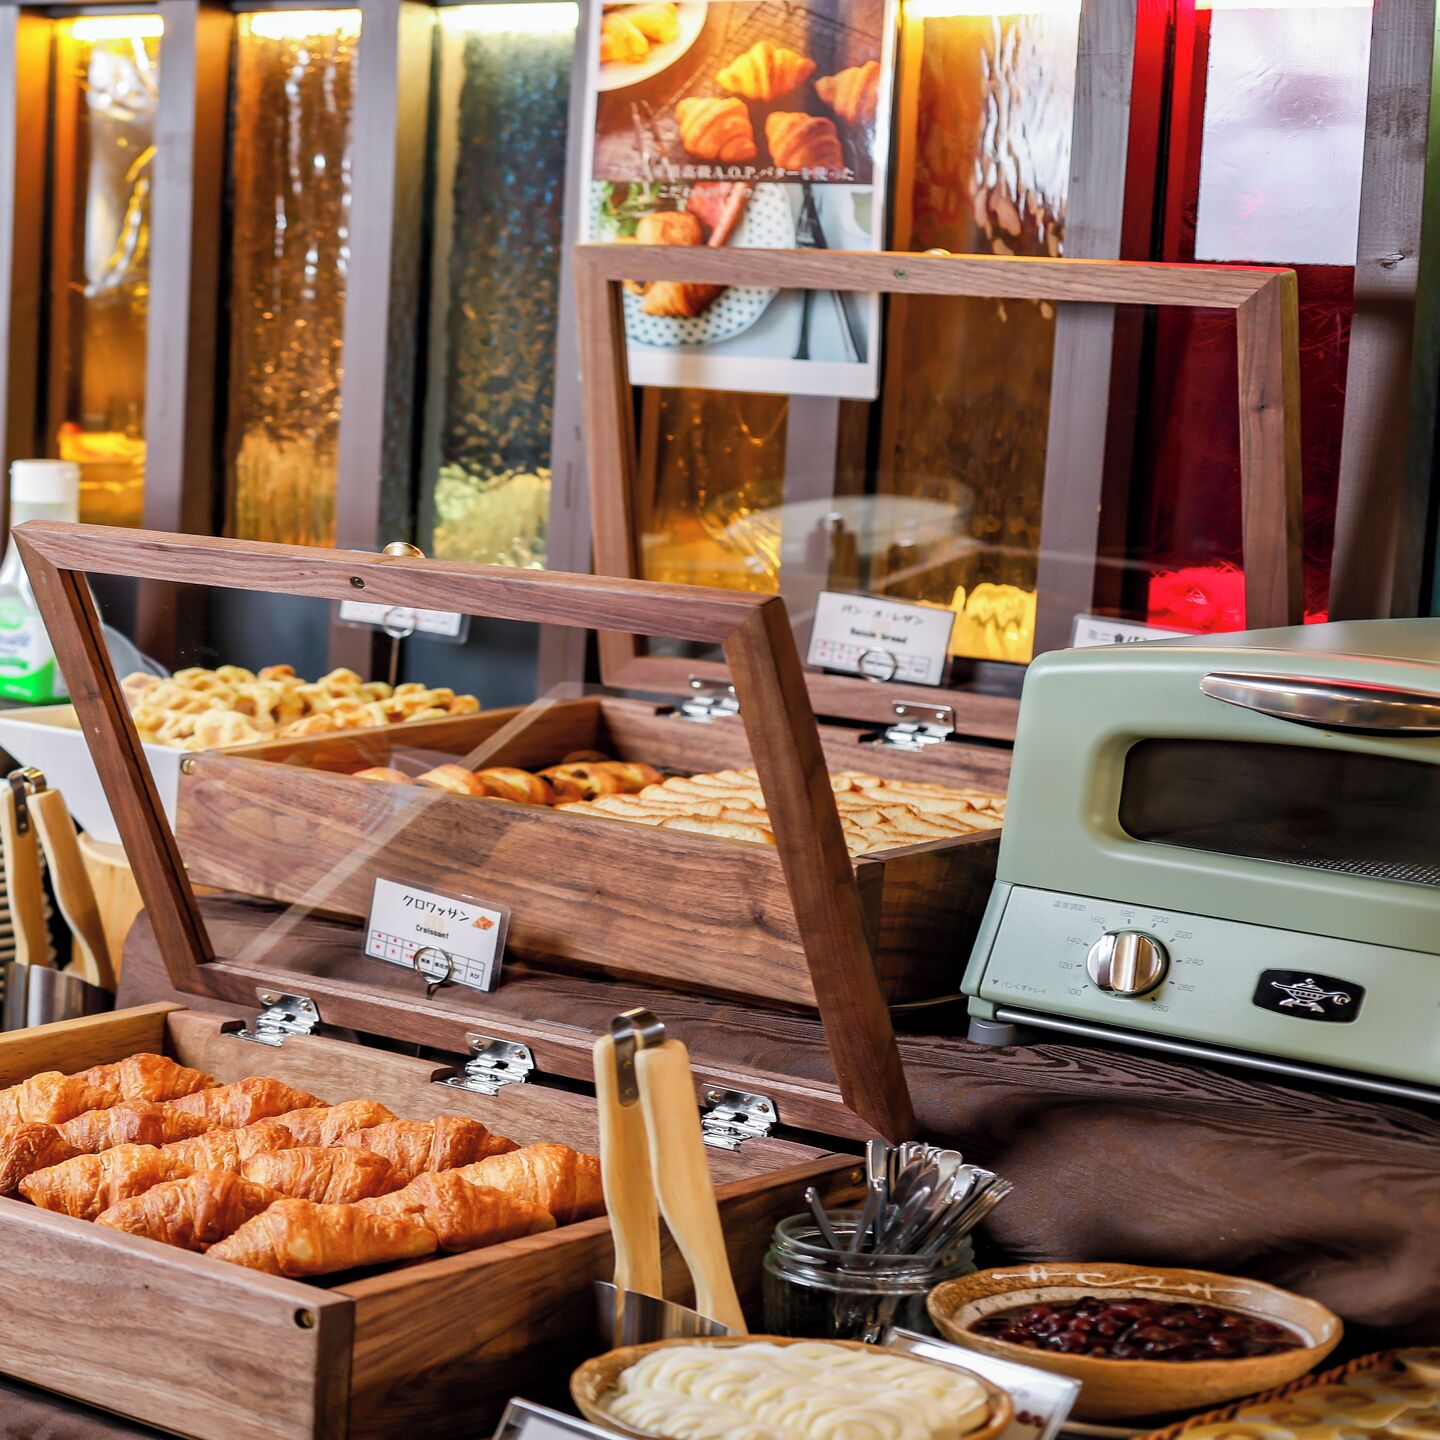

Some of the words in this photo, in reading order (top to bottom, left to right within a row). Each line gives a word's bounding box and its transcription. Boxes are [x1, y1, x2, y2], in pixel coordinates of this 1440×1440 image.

[403, 894, 470, 922] クロワッサン
[1151, 914, 1170, 924] 200
[415, 924, 450, 940] Croissant
[1175, 930, 1193, 940] 220
[1066, 936, 1082, 945] 140
[1058, 961, 1074, 970] 120
[1185, 957, 1204, 967] 240
[1067, 987, 1082, 997] 100
